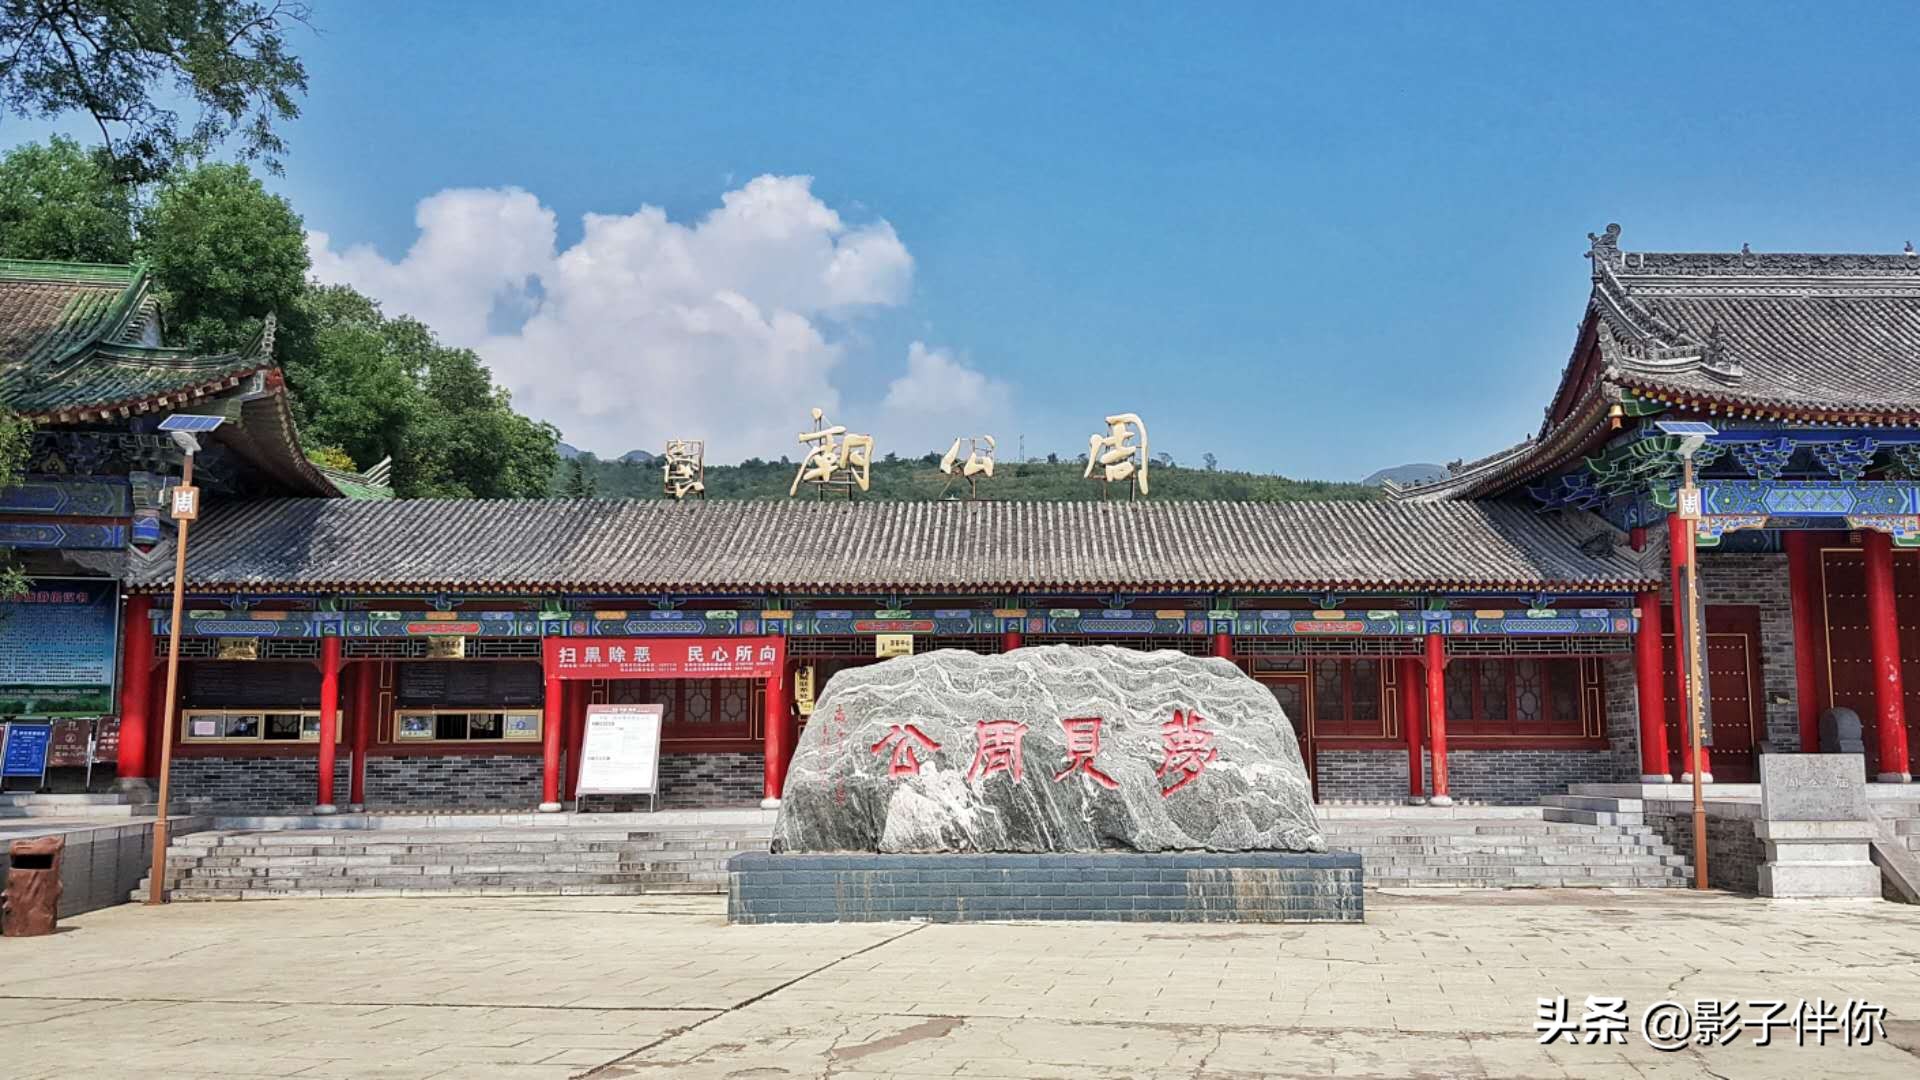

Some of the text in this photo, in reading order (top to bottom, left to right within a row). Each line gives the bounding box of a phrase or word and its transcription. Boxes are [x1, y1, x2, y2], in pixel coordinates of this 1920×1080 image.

[559, 645, 776, 663] 扫黑除恶 民心所向
